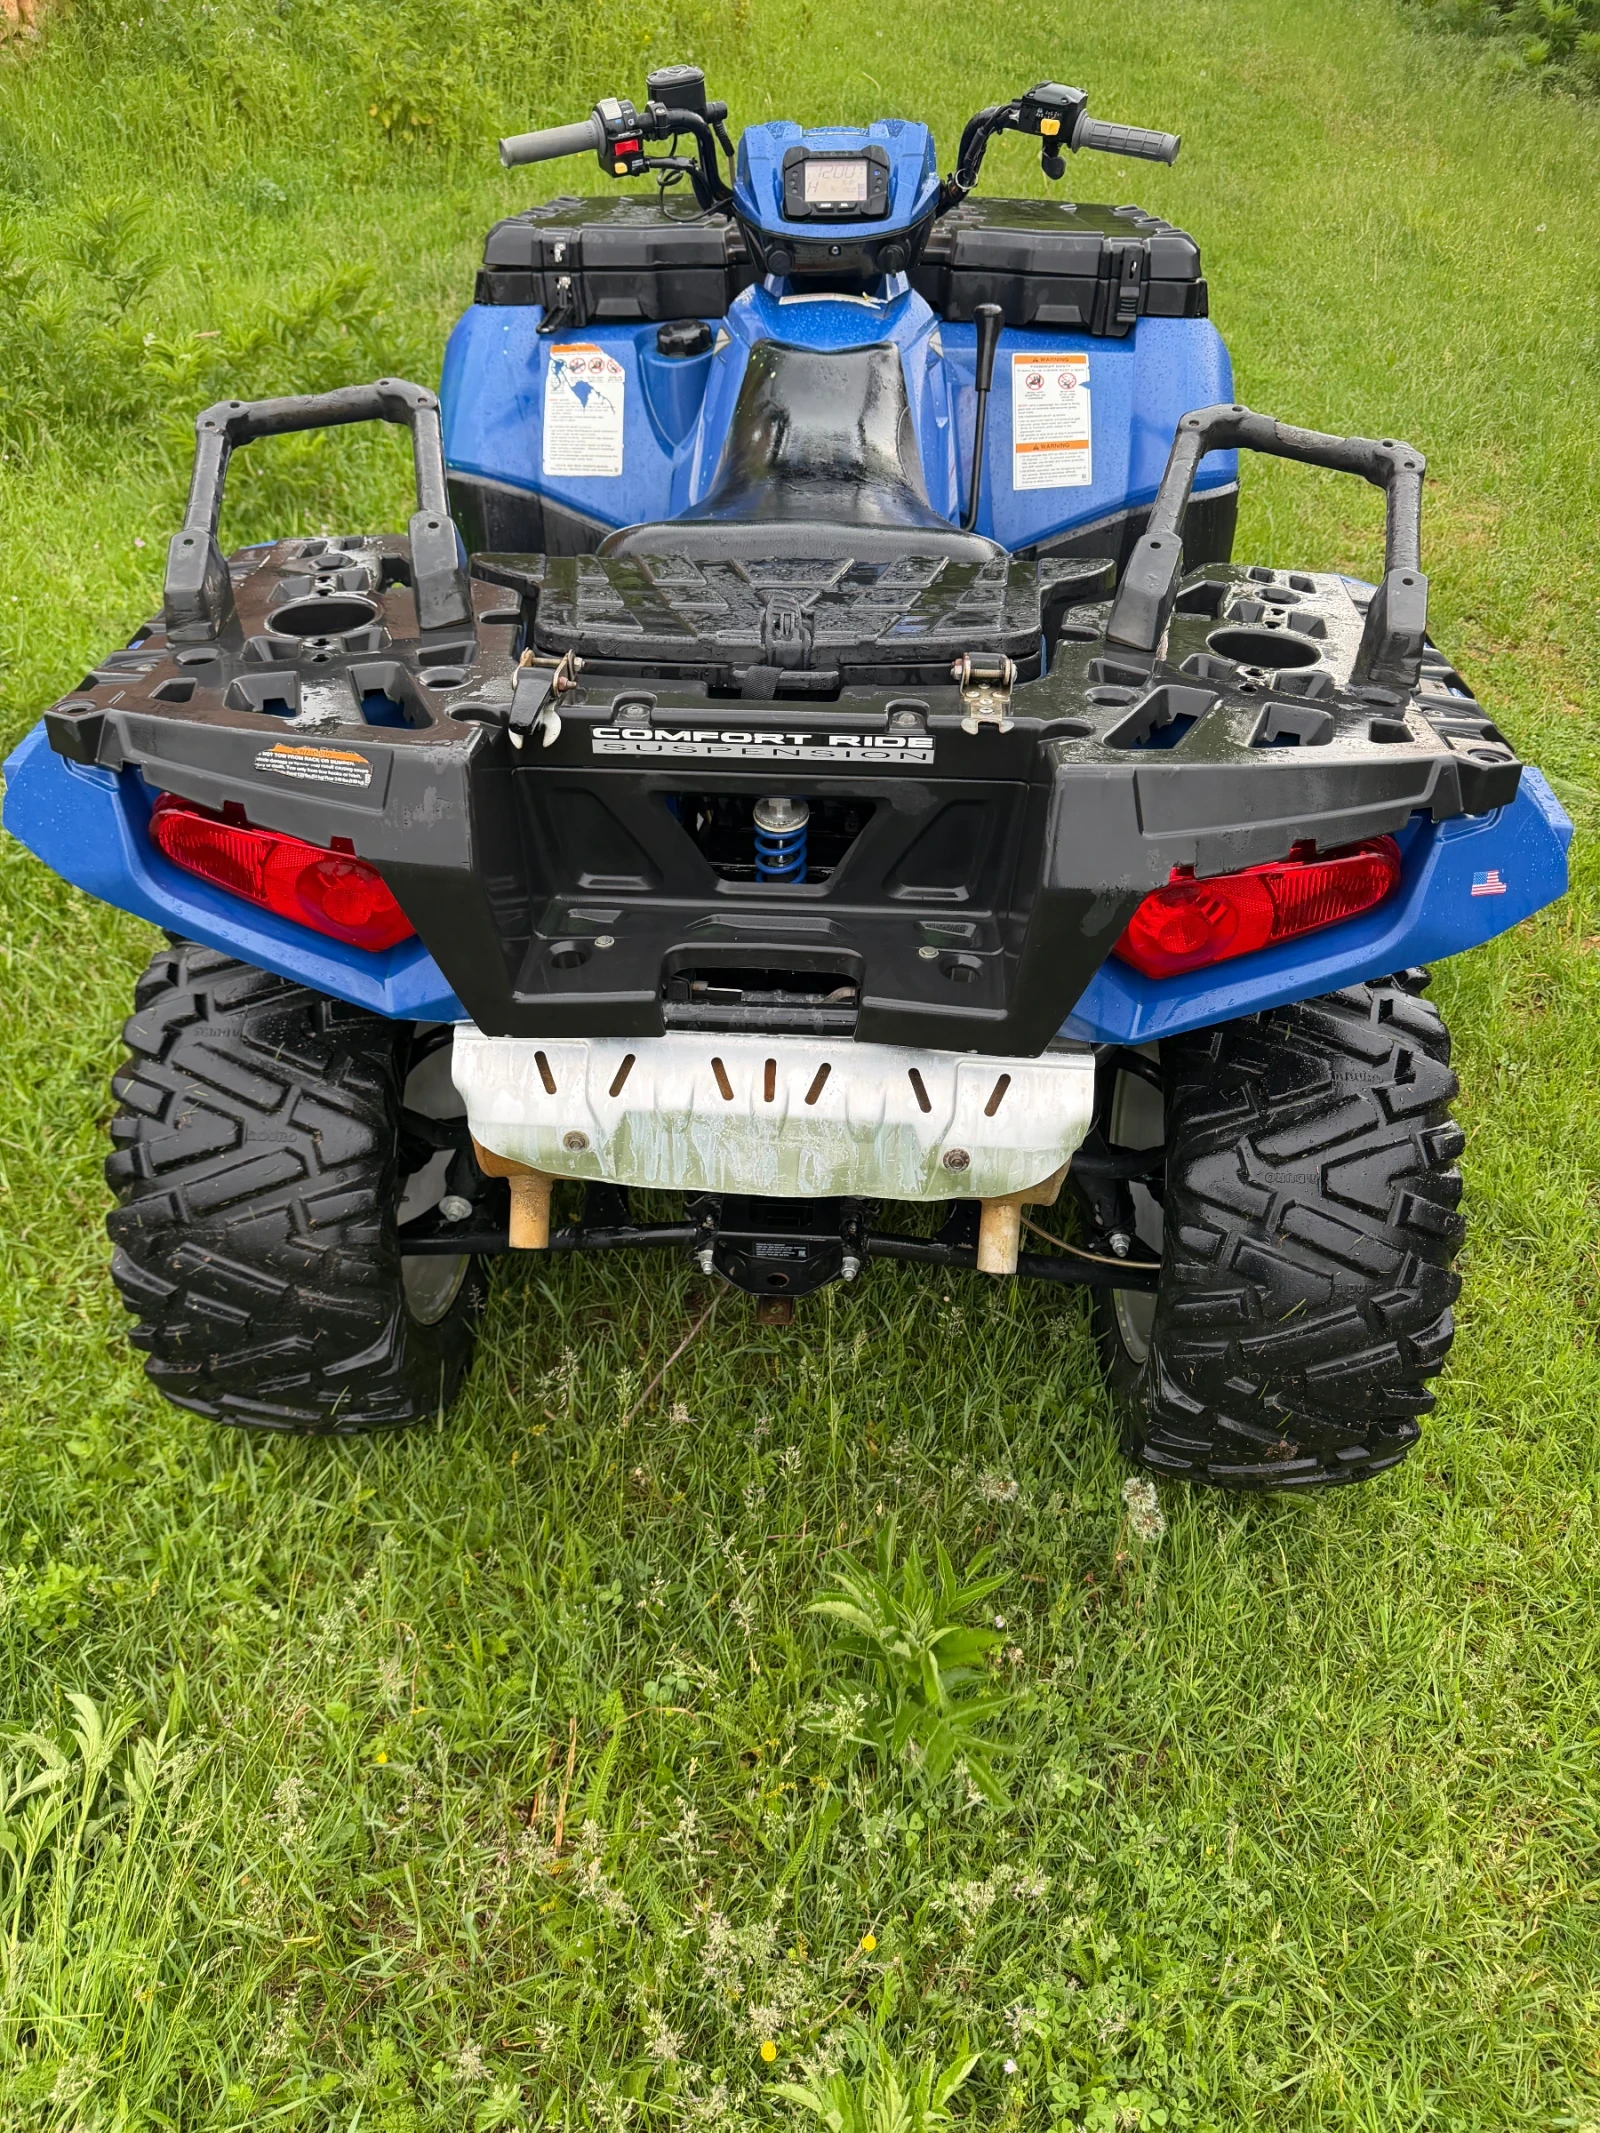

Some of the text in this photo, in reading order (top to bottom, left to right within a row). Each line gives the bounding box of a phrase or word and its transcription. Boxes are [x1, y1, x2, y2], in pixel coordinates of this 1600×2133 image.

[593, 728, 933, 749] COMFORT RIDE
[603, 743, 927, 761] SUSPENSION
